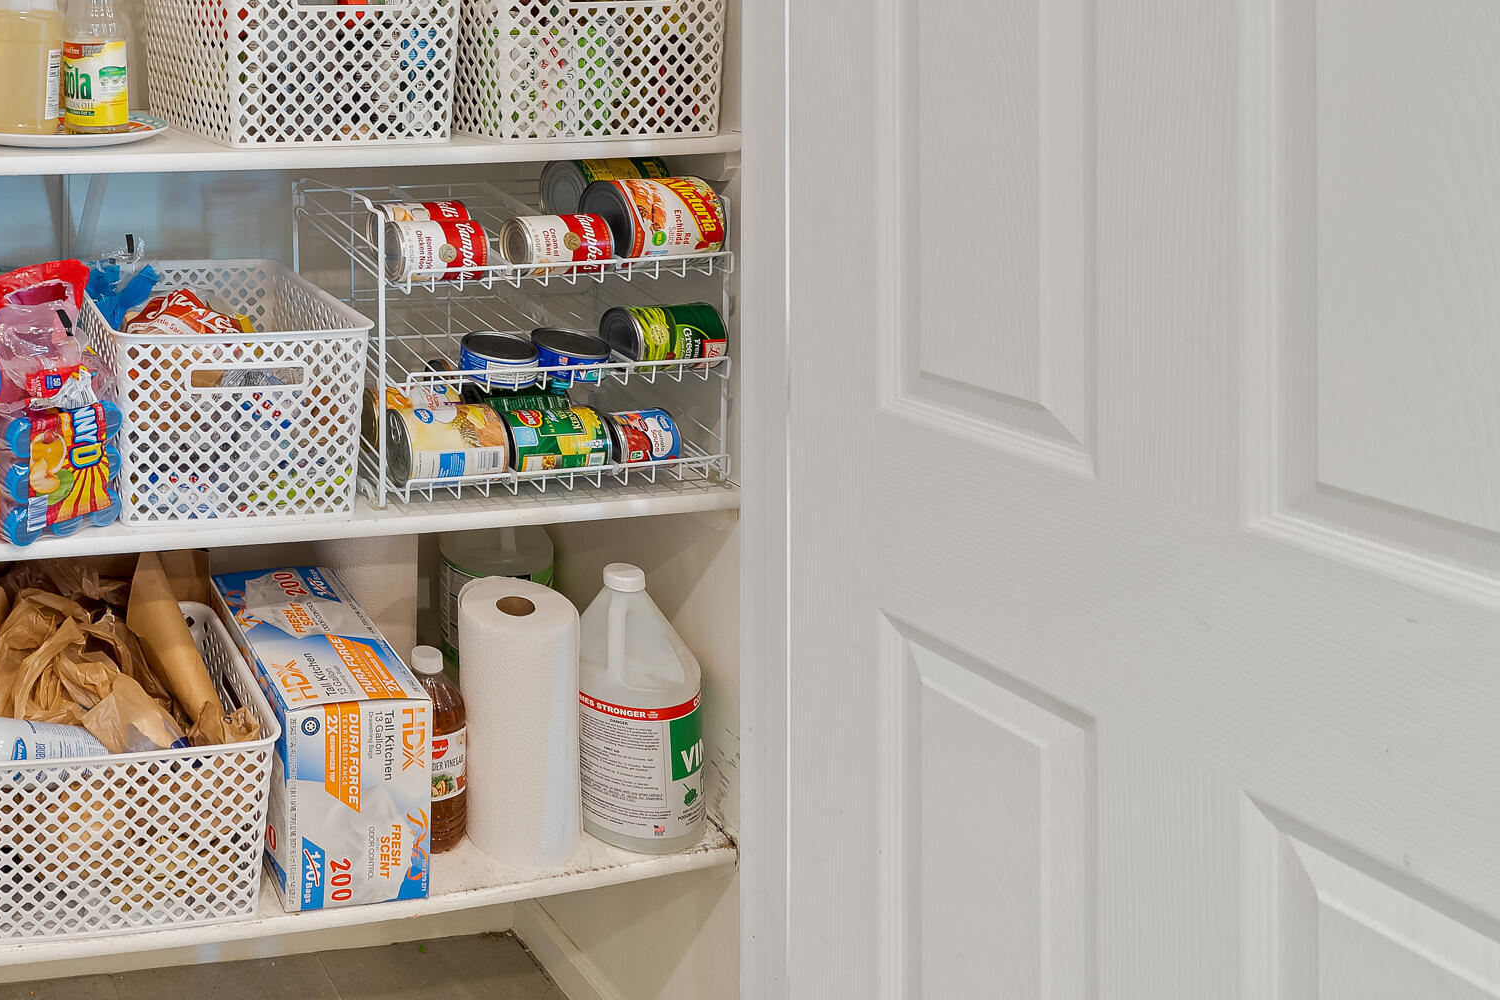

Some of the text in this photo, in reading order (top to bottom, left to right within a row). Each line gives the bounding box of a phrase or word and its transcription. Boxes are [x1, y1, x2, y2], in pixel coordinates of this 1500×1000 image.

[668, 180, 717, 232] Victoria
[549, 227, 559, 250] Cream
[674, 209, 684, 246] Enchilada
[683, 232, 691, 245] Red
[415, 230, 425, 256] Chicken
[542, 230, 551, 256] Chicken
[272, 571, 310, 598] 200
[281, 609, 307, 634] FRESH
[289, 602, 315, 627] SCENT
[304, 652, 326, 683] Kitchen
[331, 636, 377, 694] DURA FORCE
[271, 659, 319, 702] HDX
[325, 714, 338, 735] 2X
[596, 702, 647, 719] STRONGER
[609, 718, 629, 726] DANGER
[375, 711, 384, 756] 13 Gallon
[384, 710, 395, 781] Tall Kitchen
[402, 707, 426, 771] HDX
[348, 712, 359, 805] DURA FORCE
[444, 754, 464, 769] VINEGAR
[379, 835, 390, 880] SCENT
[391, 824, 402, 867] FRESH
[303, 882, 313, 904] Bags
[329, 858, 352, 901] 200
